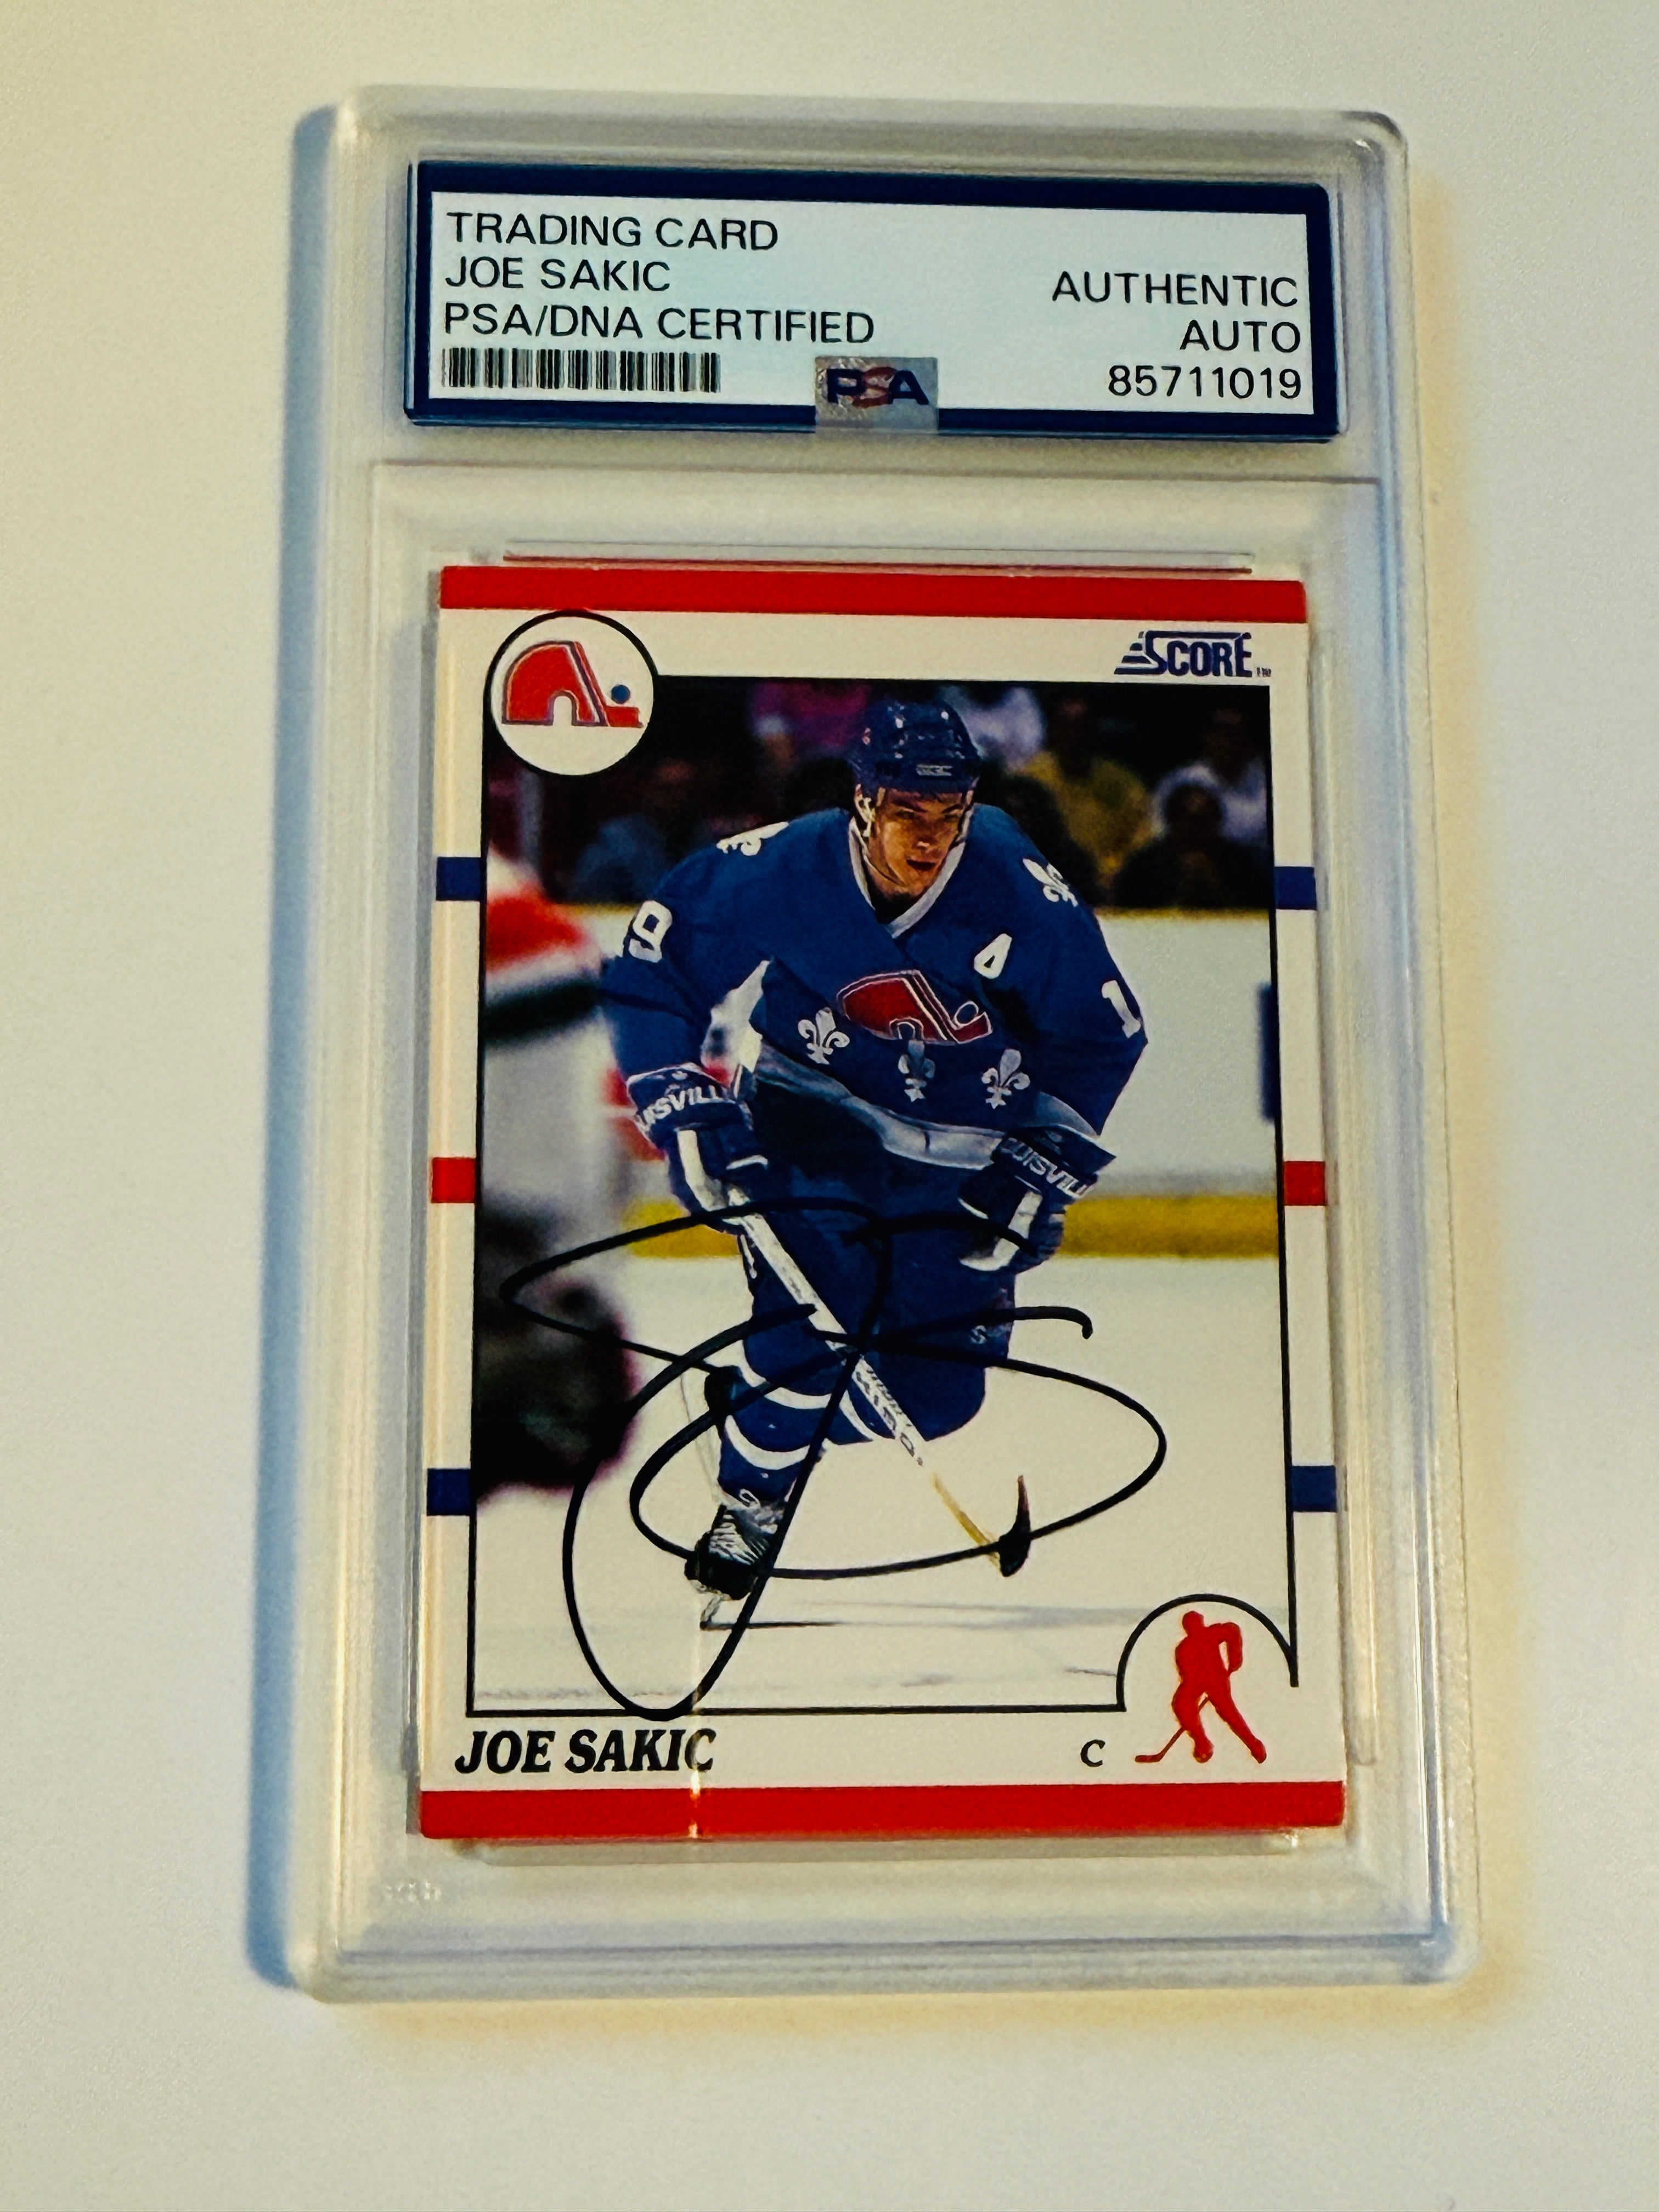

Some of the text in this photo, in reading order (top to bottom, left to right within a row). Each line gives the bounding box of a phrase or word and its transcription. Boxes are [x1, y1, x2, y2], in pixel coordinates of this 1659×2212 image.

[447, 212, 778, 251] TRADING CARD
[445, 256, 670, 292] JOE SAKIC
[1052, 270, 1298, 307] AUTHENTIC
[445, 302, 874, 343] PSA/DNA CERTIFIED
[1179, 319, 1301, 353] AUTO
[827, 366, 929, 409] PSA
[1108, 365, 1301, 399] 85711019
[1114, 630, 1253, 678] SCORE
[455, 1728, 717, 1774] JOE SAKIC
[1080, 1739, 1105, 1768] C
